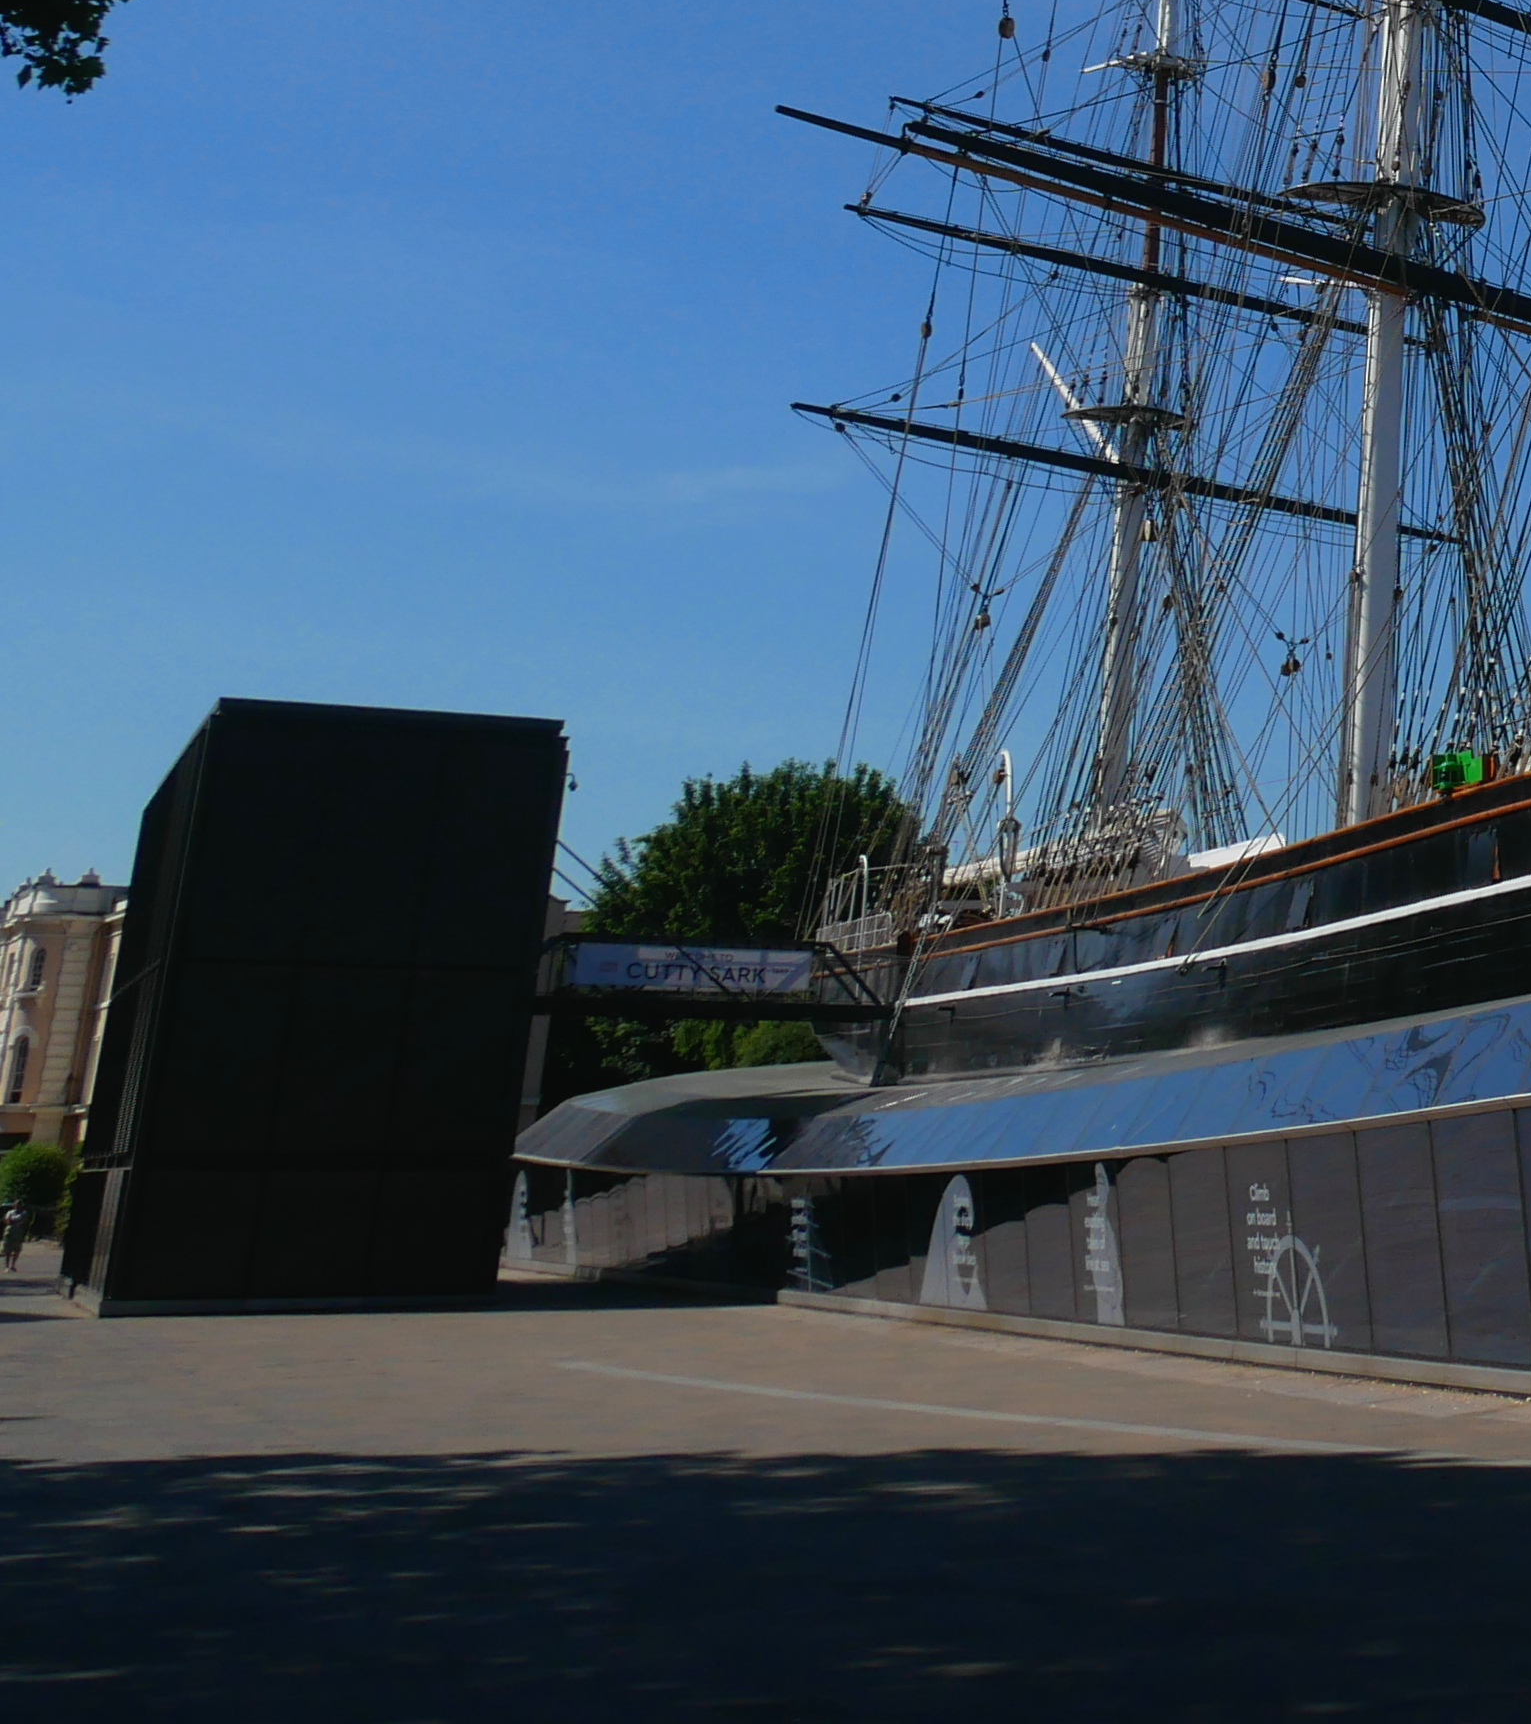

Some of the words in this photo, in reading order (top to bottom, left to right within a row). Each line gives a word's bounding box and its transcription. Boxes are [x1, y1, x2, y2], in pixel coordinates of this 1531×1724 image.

[665, 951, 717, 962] WECOME
[627, 962, 701, 980] CUTTY
[709, 965, 766, 983] SARK
[1249, 1182, 1270, 1202] Climb
[1246, 1212, 1256, 1226] on
[1256, 1207, 1277, 1226] board
[1247, 1231, 1260, 1250] and
[1261, 1231, 1280, 1250] touch
[1253, 1255, 1276, 1279] history
